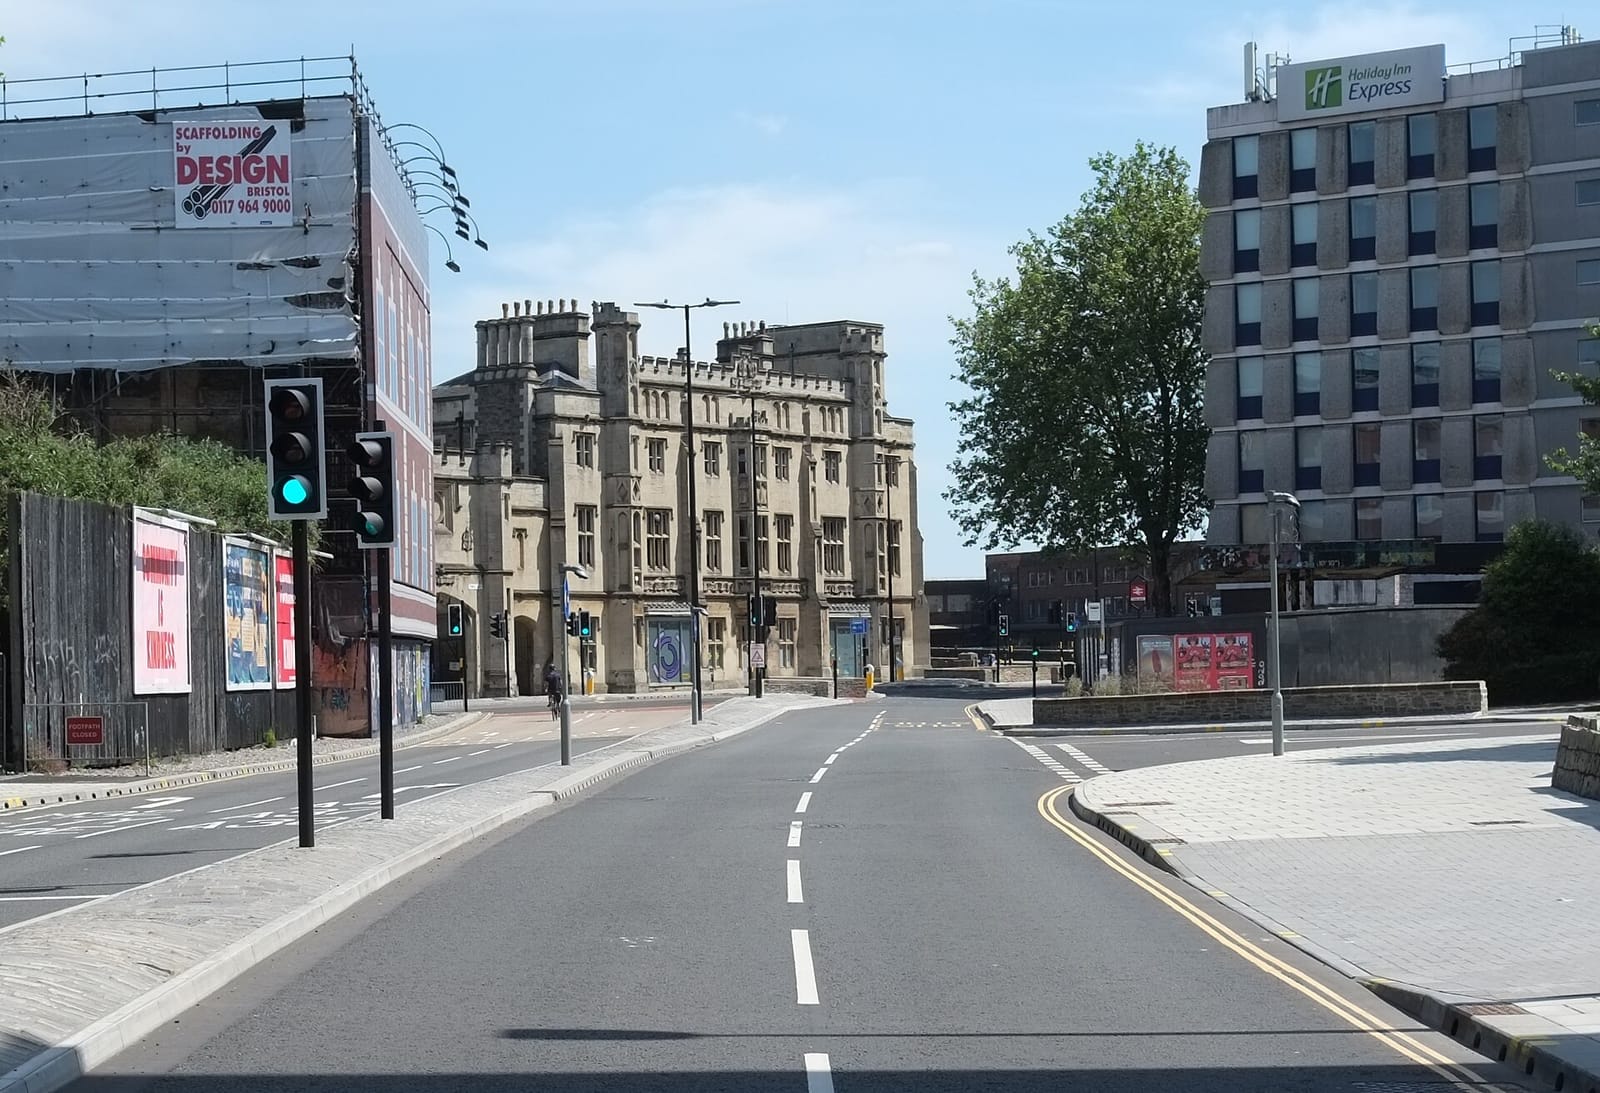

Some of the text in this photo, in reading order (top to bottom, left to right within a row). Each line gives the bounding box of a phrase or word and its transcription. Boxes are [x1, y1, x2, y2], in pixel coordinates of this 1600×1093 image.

[1348, 63, 1412, 80] Holiday Inn
[1348, 79, 1412, 102] Express
[175, 126, 261, 140] SCAFFOLDING
[176, 142, 191, 154] by
[176, 154, 289, 185] DESIGN
[247, 186, 290, 197] BRISTOL
[211, 199, 291, 214] 0117 964 9000
[157, 588, 164, 627] IS
